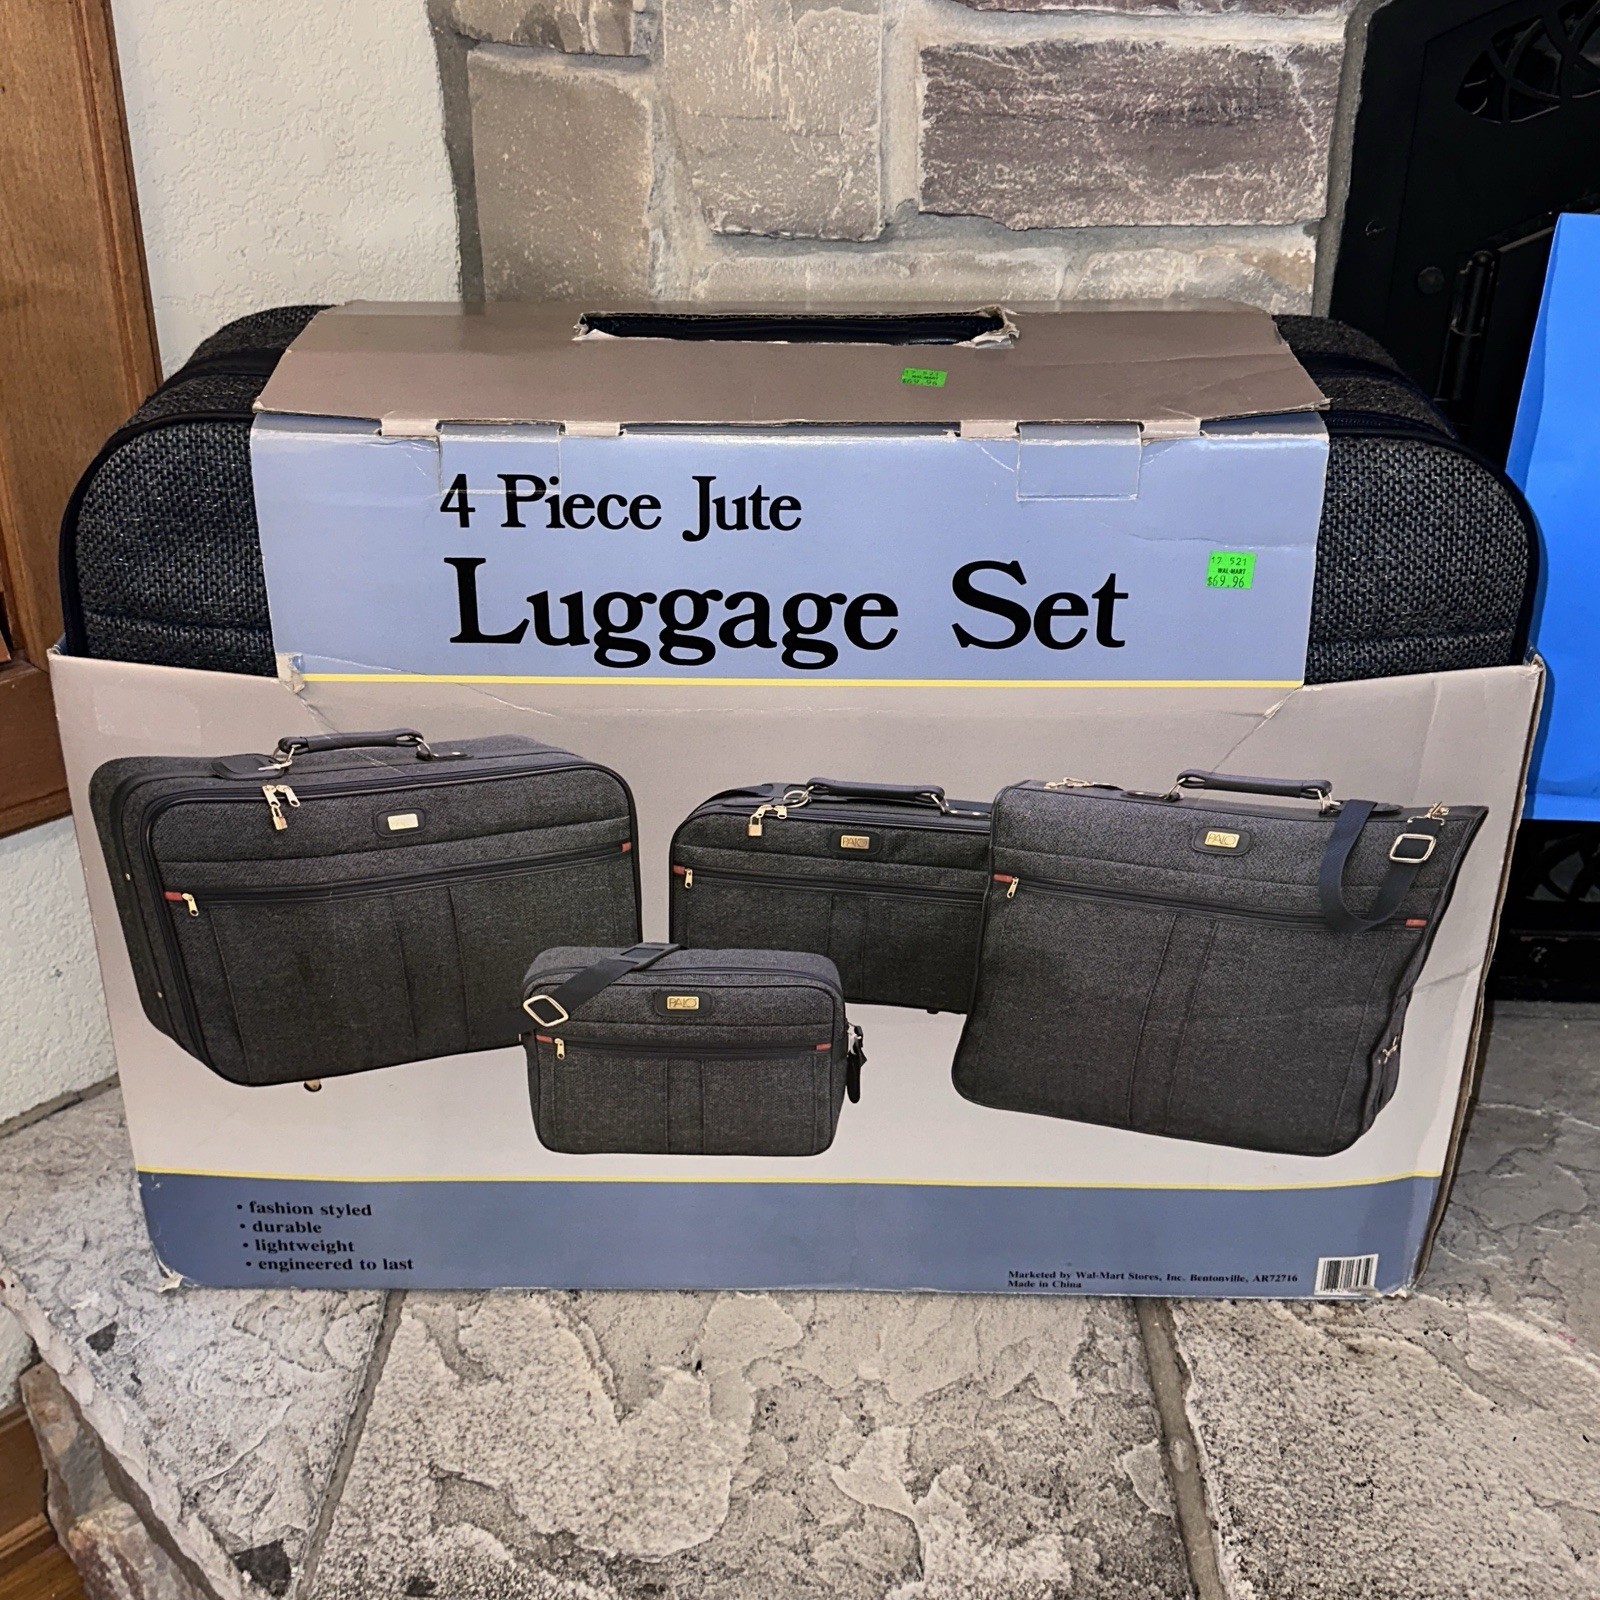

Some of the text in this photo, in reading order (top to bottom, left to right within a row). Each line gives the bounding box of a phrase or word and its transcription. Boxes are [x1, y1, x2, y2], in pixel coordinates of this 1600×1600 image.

[440, 473, 802, 541] 4 Piece Jute
[1230, 557, 1246, 566] 521
[1207, 575, 1245, 588] $69.96
[444, 557, 1129, 669] Luggage Set
[249, 1201, 372, 1218] fashion styled
[252, 1220, 322, 1233] durable
[255, 1239, 355, 1254] lightweight
[258, 1258, 414, 1273] engineered to last
[1008, 1270, 1298, 1283] Marketed by Wal-Mart Stores, Inc. Bentonville, AR72716
[1007, 1280, 1082, 1288] Made in China
